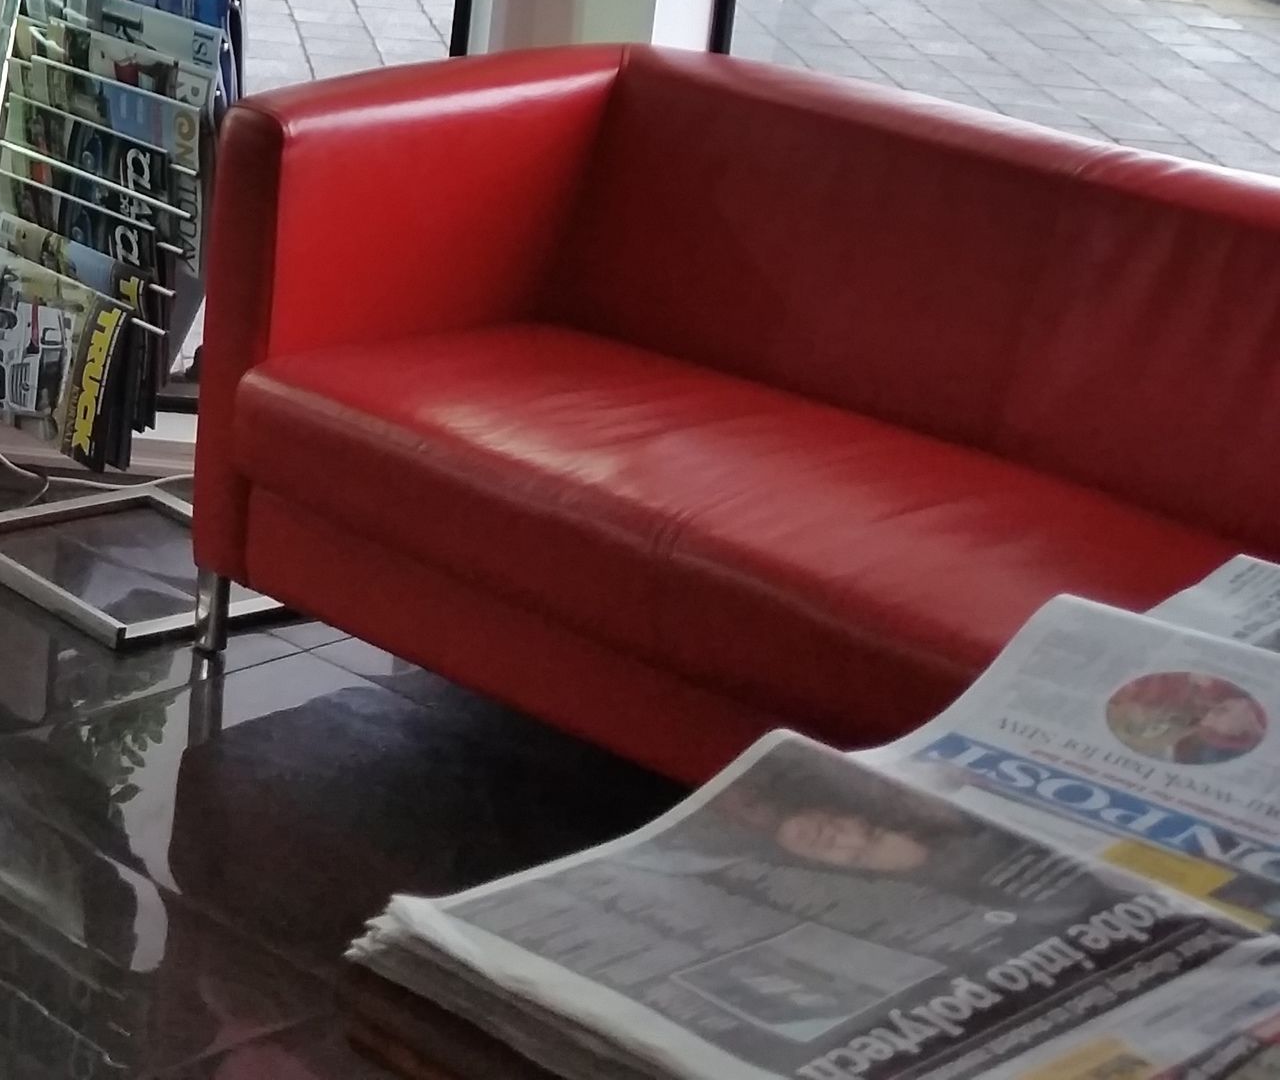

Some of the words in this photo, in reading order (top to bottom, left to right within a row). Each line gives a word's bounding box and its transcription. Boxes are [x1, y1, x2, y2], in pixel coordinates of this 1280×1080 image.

[71, 307, 122, 456] TRUCK
[926, 742, 1171, 832] POST
[987, 936, 1097, 988] into
[794, 974, 1004, 1080] polytech
